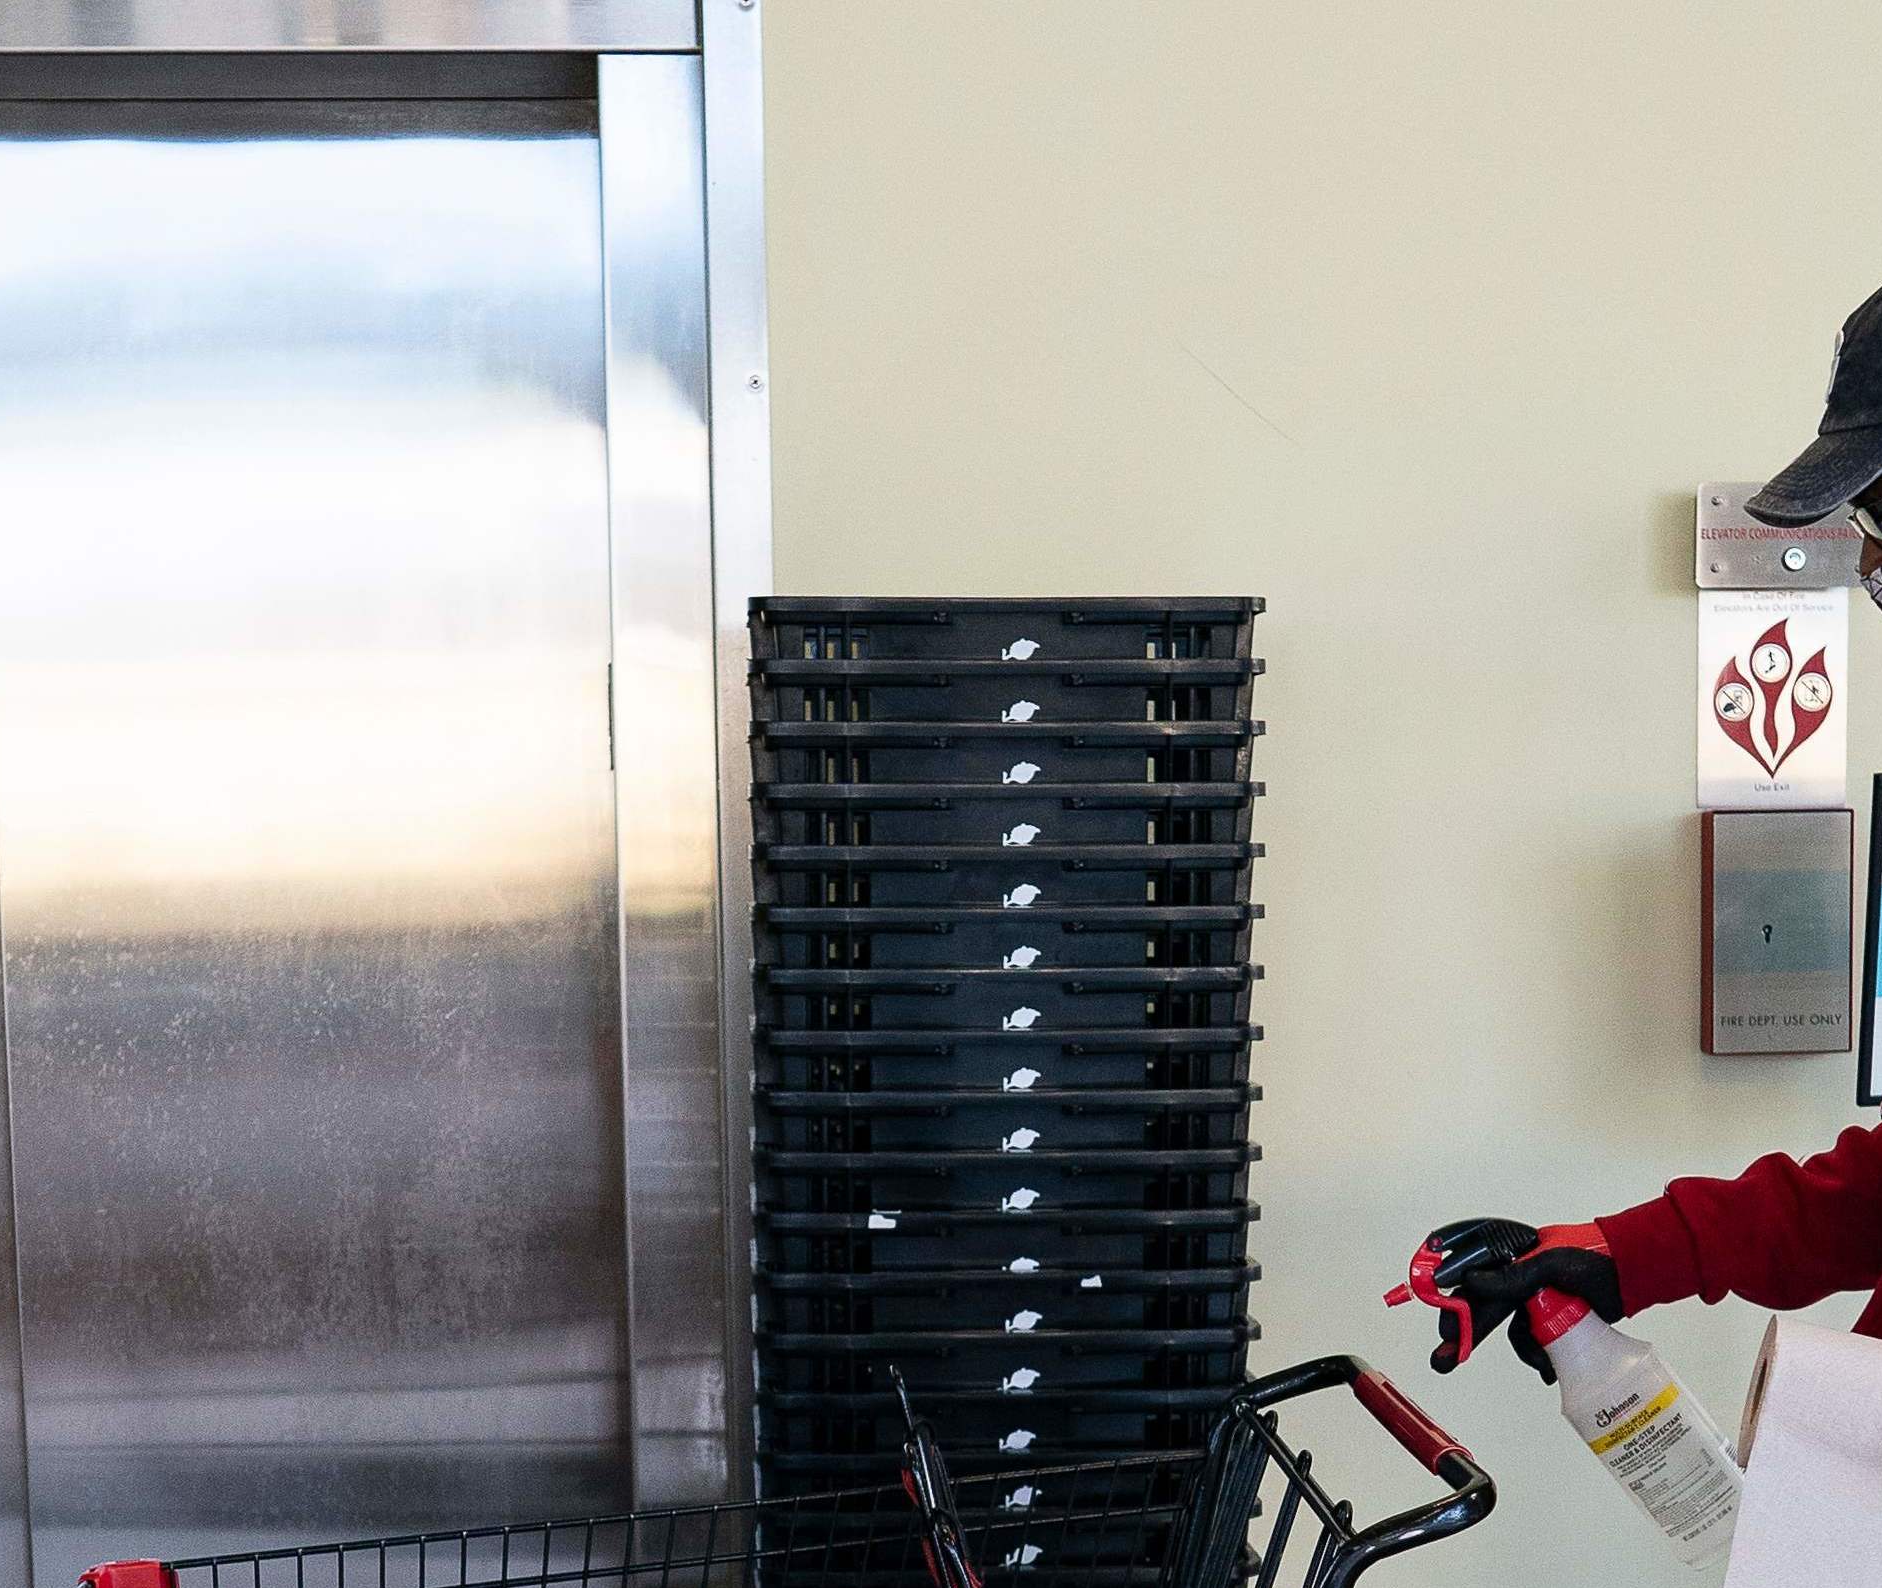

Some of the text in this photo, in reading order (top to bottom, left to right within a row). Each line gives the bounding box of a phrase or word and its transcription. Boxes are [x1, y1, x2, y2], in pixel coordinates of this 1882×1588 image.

[1701, 528, 1747, 540] ELEVATOR
[1754, 783, 1771, 792] Use
[1720, 1015, 1744, 1027] FIRE
[1783, 1015, 1805, 1026] USE
[1809, 1013, 1842, 1025] ONLY
